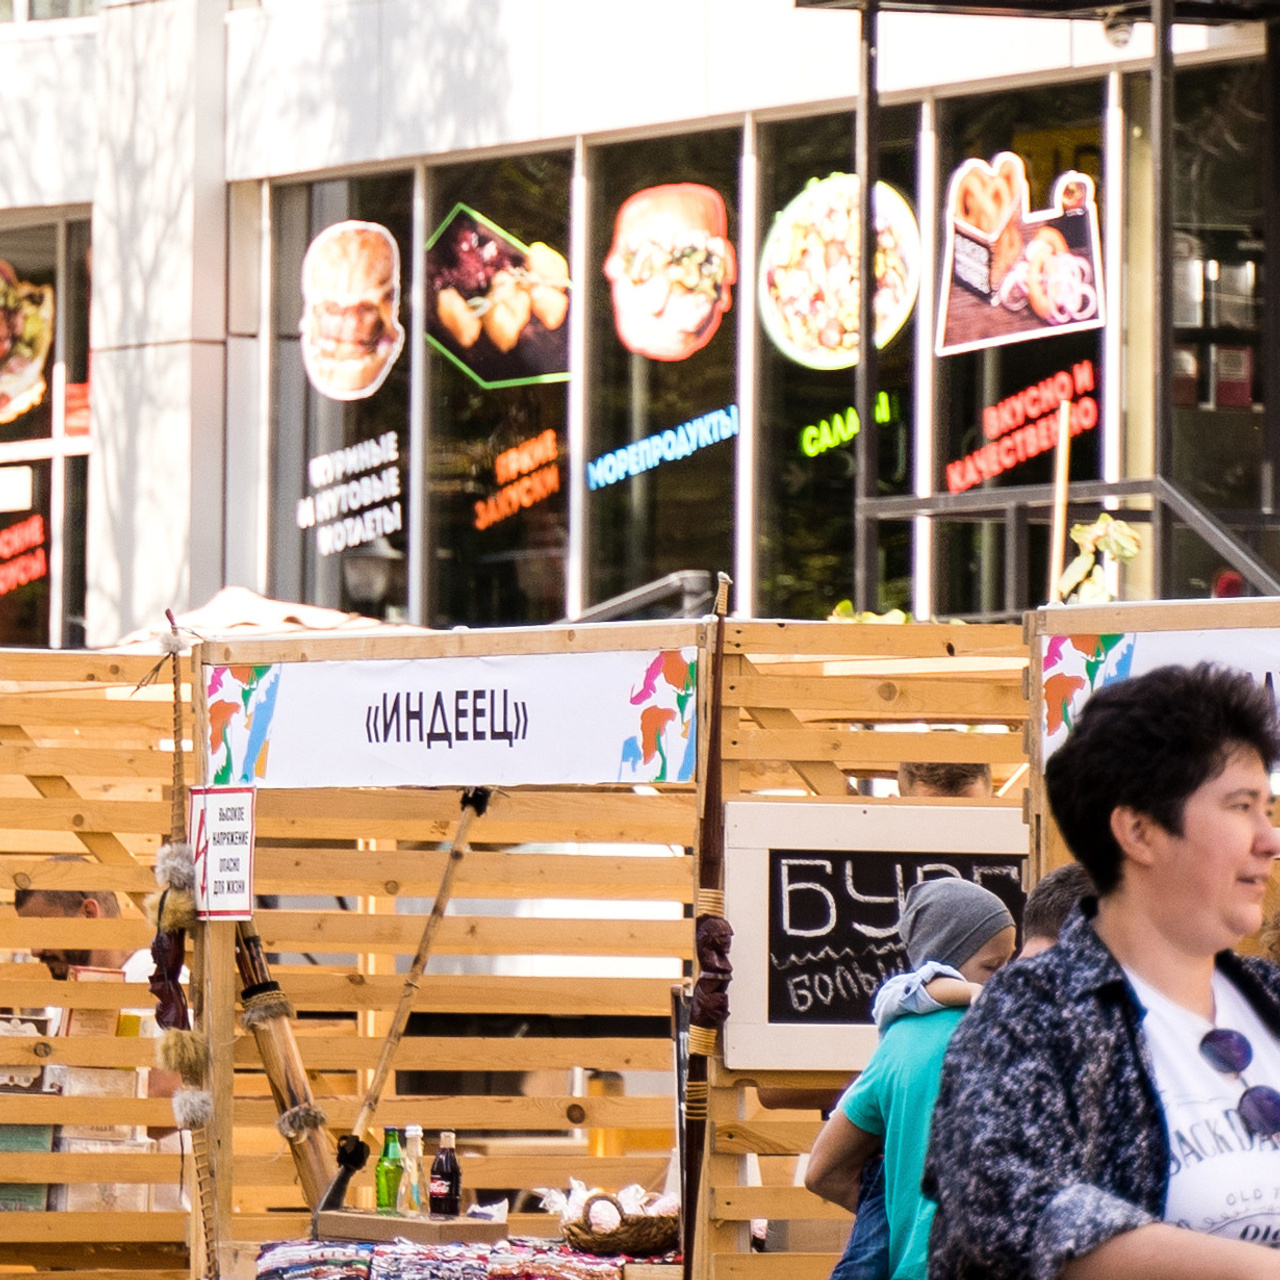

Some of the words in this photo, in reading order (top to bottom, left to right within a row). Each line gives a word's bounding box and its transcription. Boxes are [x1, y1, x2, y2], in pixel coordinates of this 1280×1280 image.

[802, 391, 891, 457] САЛАЫ
[983, 371, 1073, 440] ВКУСНО
[1073, 360, 1094, 394] И
[588, 404, 739, 490] МОРЕПРОДУКТЫ
[365, 688, 529, 748] «ИНДЕЕЦ»
[1226, 1188, 1262, 1205] OLD
